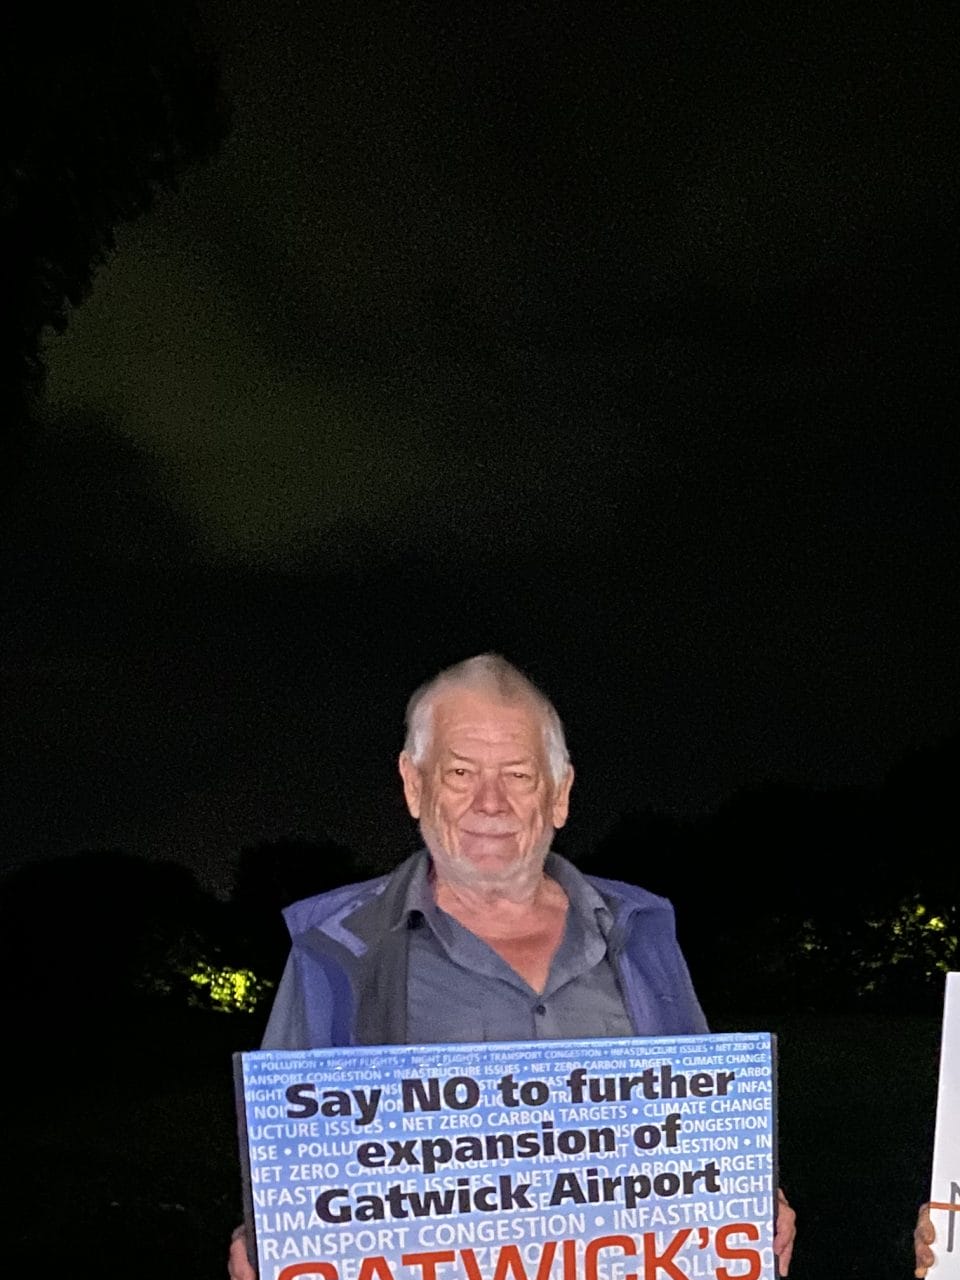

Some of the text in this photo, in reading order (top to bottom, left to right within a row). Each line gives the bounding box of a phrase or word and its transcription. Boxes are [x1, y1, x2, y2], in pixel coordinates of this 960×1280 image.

[733, 1041, 754, 1052] ZERO
[306, 1069, 383, 1082] CONGESTION
[484, 1063, 521, 1076] ISSUES
[531, 1062, 552, 1074] NET
[583, 1058, 626, 1072] CARBON
[682, 1055, 725, 1068] CLIMATE
[726, 1053, 767, 1065] CHANGE
[286, 1083, 382, 1125] Say
[402, 1076, 480, 1113] NO
[498, 1074, 549, 1107] to
[567, 1065, 734, 1103] further
[402, 1115, 436, 1132] NET
[440, 1113, 483, 1130] ZERO
[487, 1107, 554, 1127] CARBON
[559, 1104, 628, 1122] TARGETS
[643, 1100, 707, 1118] CLIMATE
[711, 1096, 772, 1114] CHANGE
[357, 1122, 615, 1173] expansion
[633, 1113, 681, 1150] of
[289, 1162, 340, 1181] ZERO
[315, 1175, 533, 1224] Gatwick
[550, 1162, 720, 1208] Airport
[418, 1212, 586, 1248] CONGESTION
